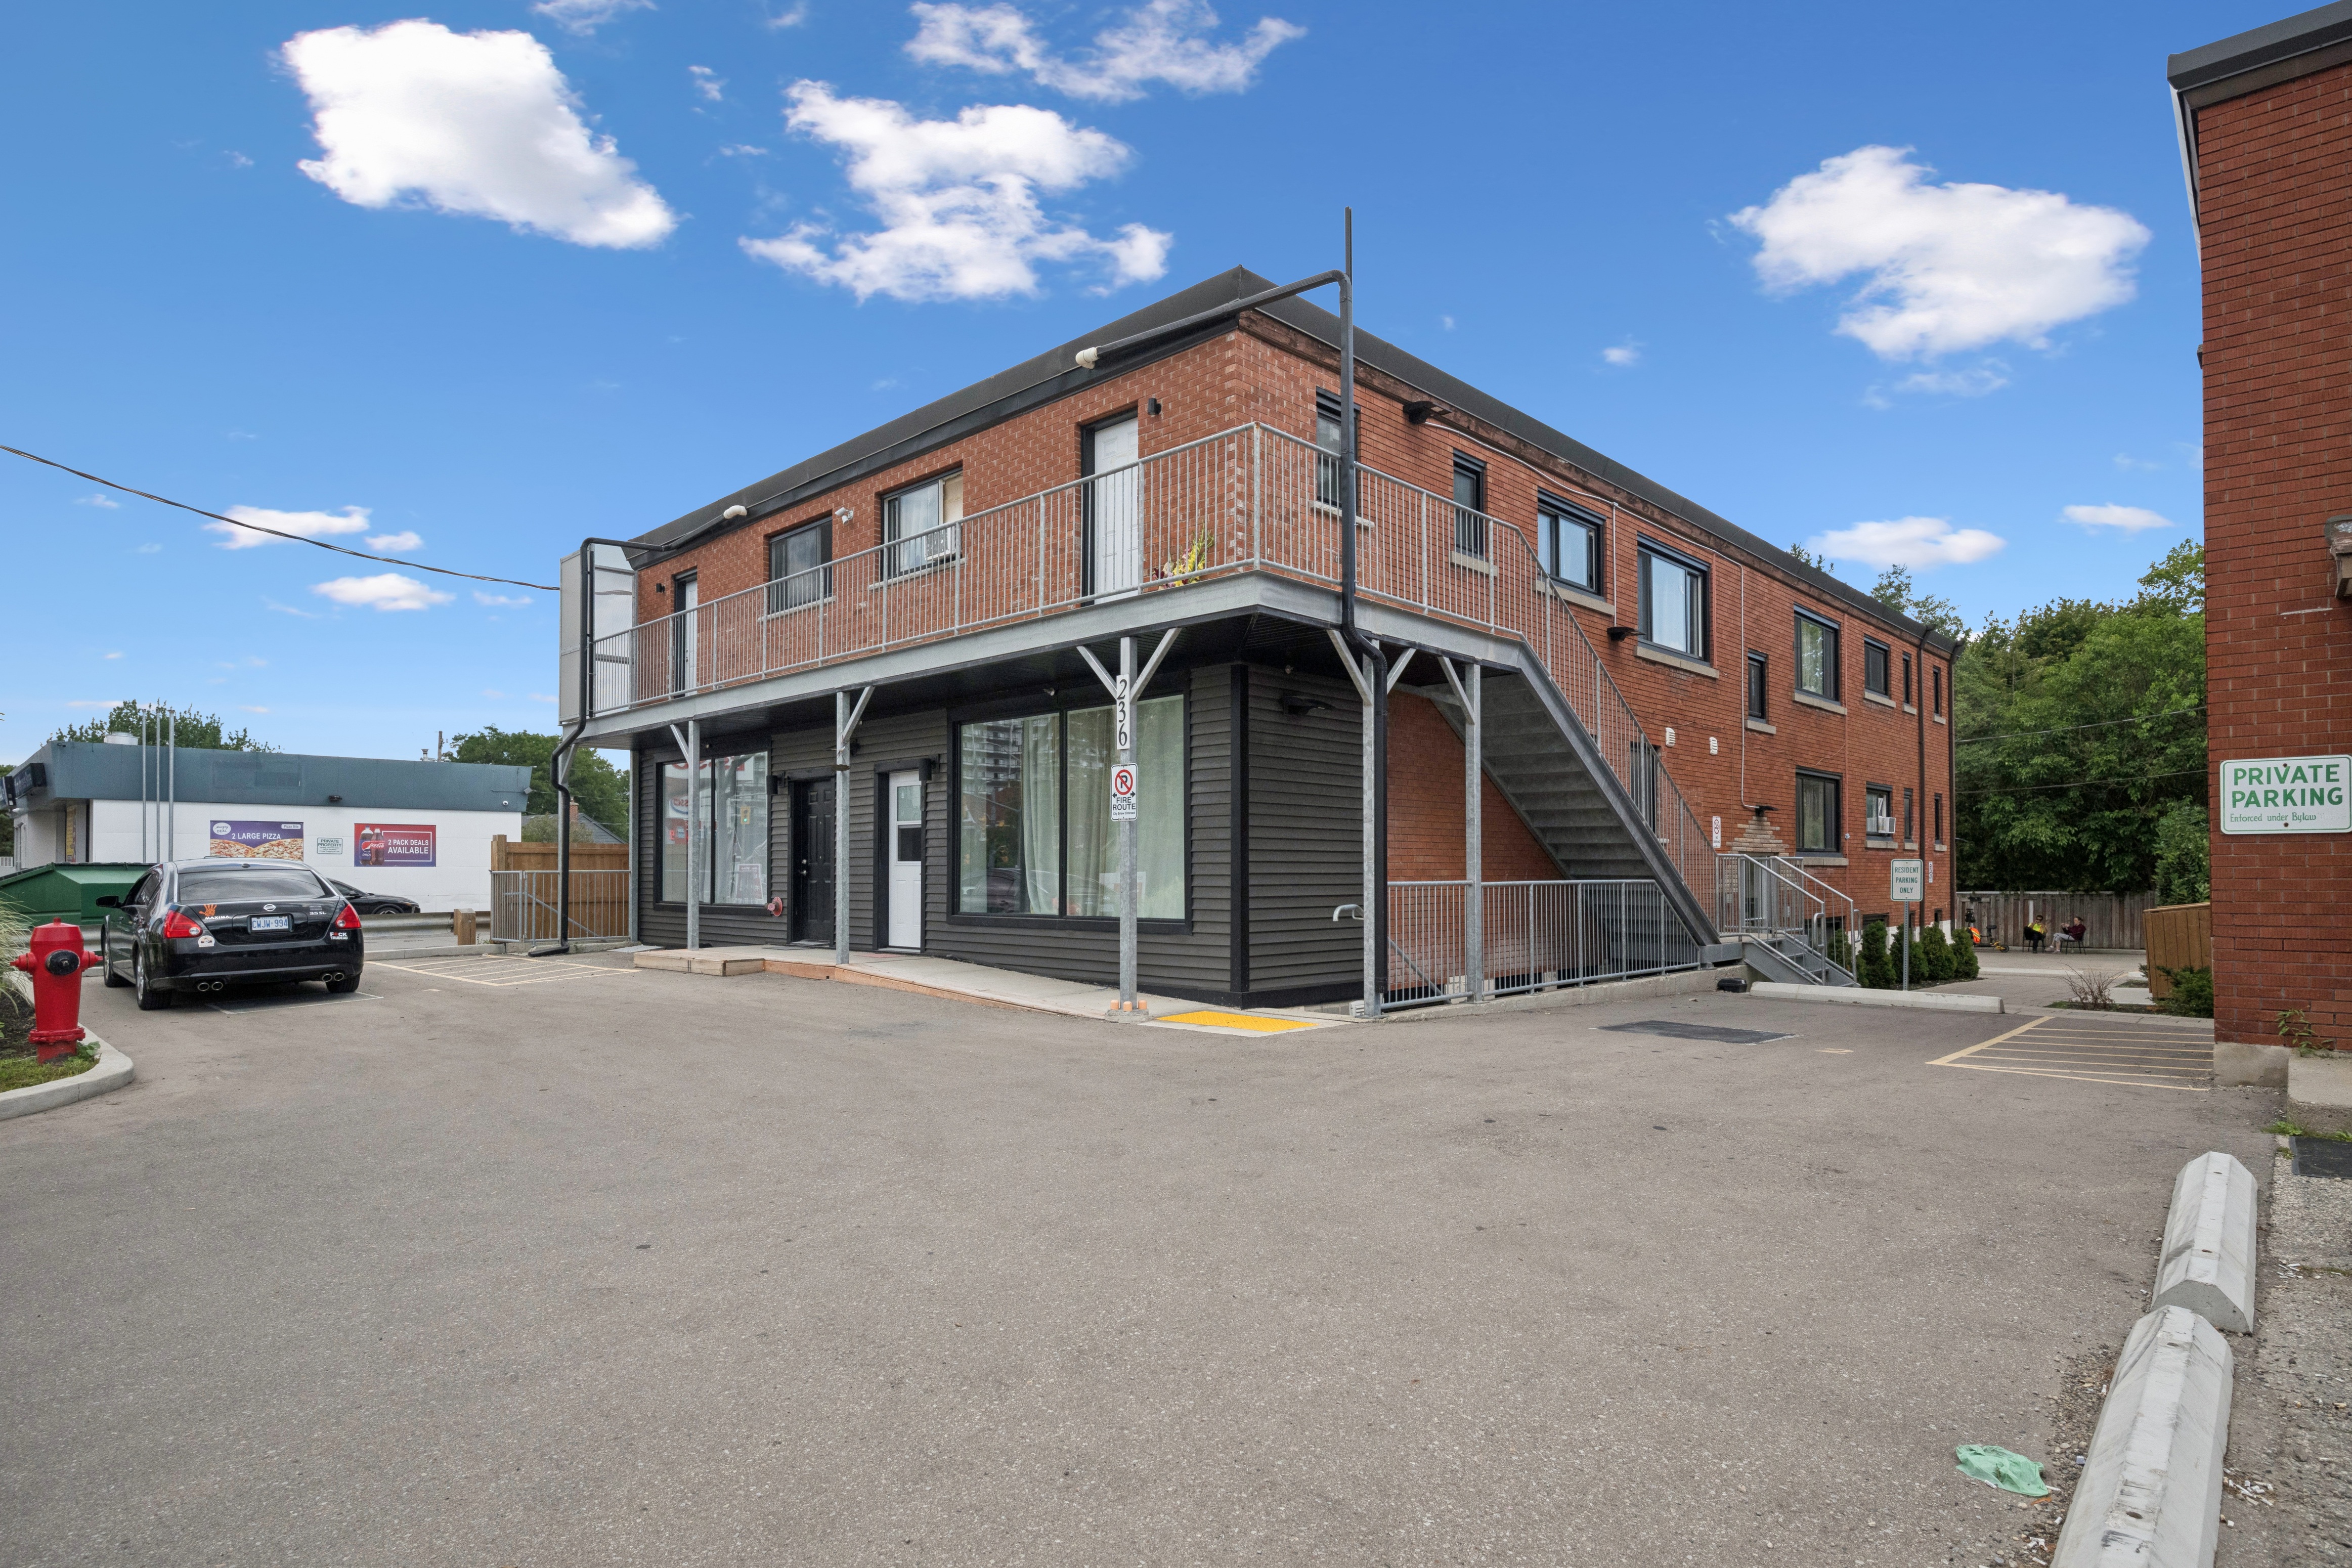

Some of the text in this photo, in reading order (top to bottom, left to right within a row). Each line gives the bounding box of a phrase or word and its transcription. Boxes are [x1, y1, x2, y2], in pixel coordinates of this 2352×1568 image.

[1117, 679, 1127, 746] 236
[2234, 764, 2339, 786] PRIVATE
[2232, 787, 2343, 808] PARKING
[2230, 813, 2262, 822] Enforced
[2267, 813, 2288, 821] under
[2292, 812, 2316, 823] Bylaw
